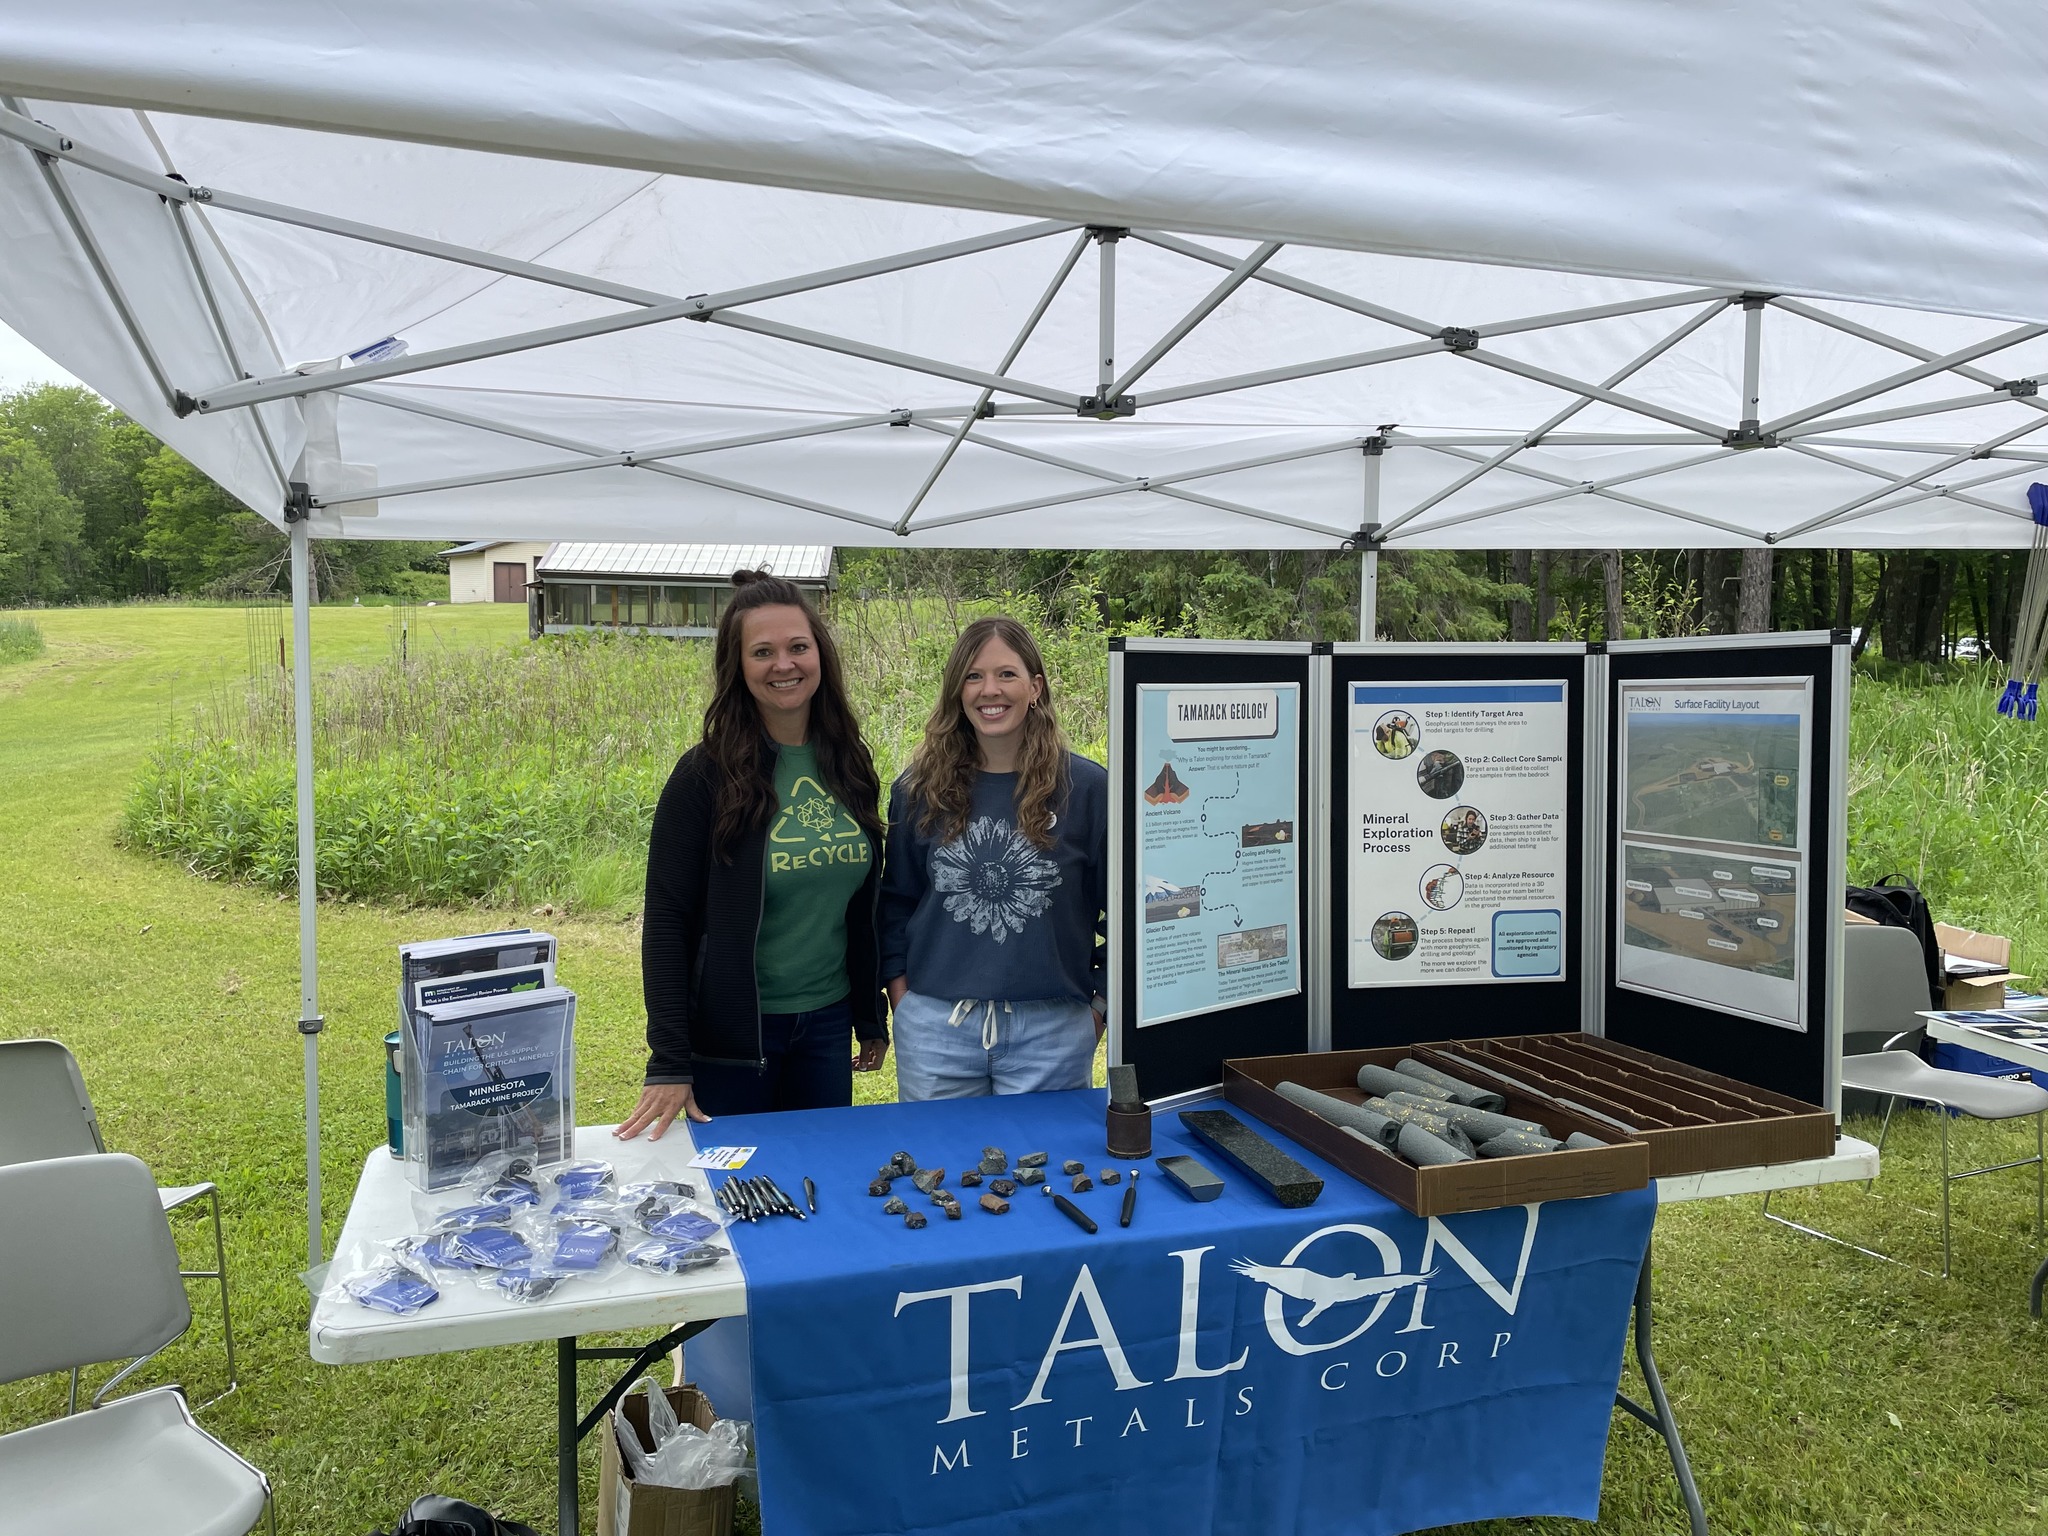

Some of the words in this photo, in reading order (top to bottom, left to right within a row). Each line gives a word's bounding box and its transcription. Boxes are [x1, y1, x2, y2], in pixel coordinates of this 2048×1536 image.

[1629, 697, 1661, 707] TALON
[1675, 699, 1702, 709] Surface
[1704, 699, 1730, 711] Facility
[1732, 700, 1759, 711] Layout
[1178, 705, 1227, 721] TAMARACK
[1231, 703, 1268, 719] GEOLOGY
[1364, 813, 1409, 824] Mineral
[1364, 828, 1433, 840] Exploration
[1364, 843, 1410, 853] Process
[444, 1032, 506, 1054] TALON
[444, 1056, 479, 1066] BUILDING
[512, 1046, 539, 1054] SUPPLY
[485, 1059, 516, 1068] CRITICAL
[519, 1051, 554, 1062] MINERALS
[469, 1080, 525, 1097] MINNESOTA
[450, 1098, 490, 1111] TAMARACK
[492, 1094, 511, 1102] MINE
[512, 1088, 544, 1099] PROJECT
[894, 1202, 1540, 1424] TALON
[931, 1386, 1254, 1476] METALS
[1321, 1332, 1511, 1391] CORP
